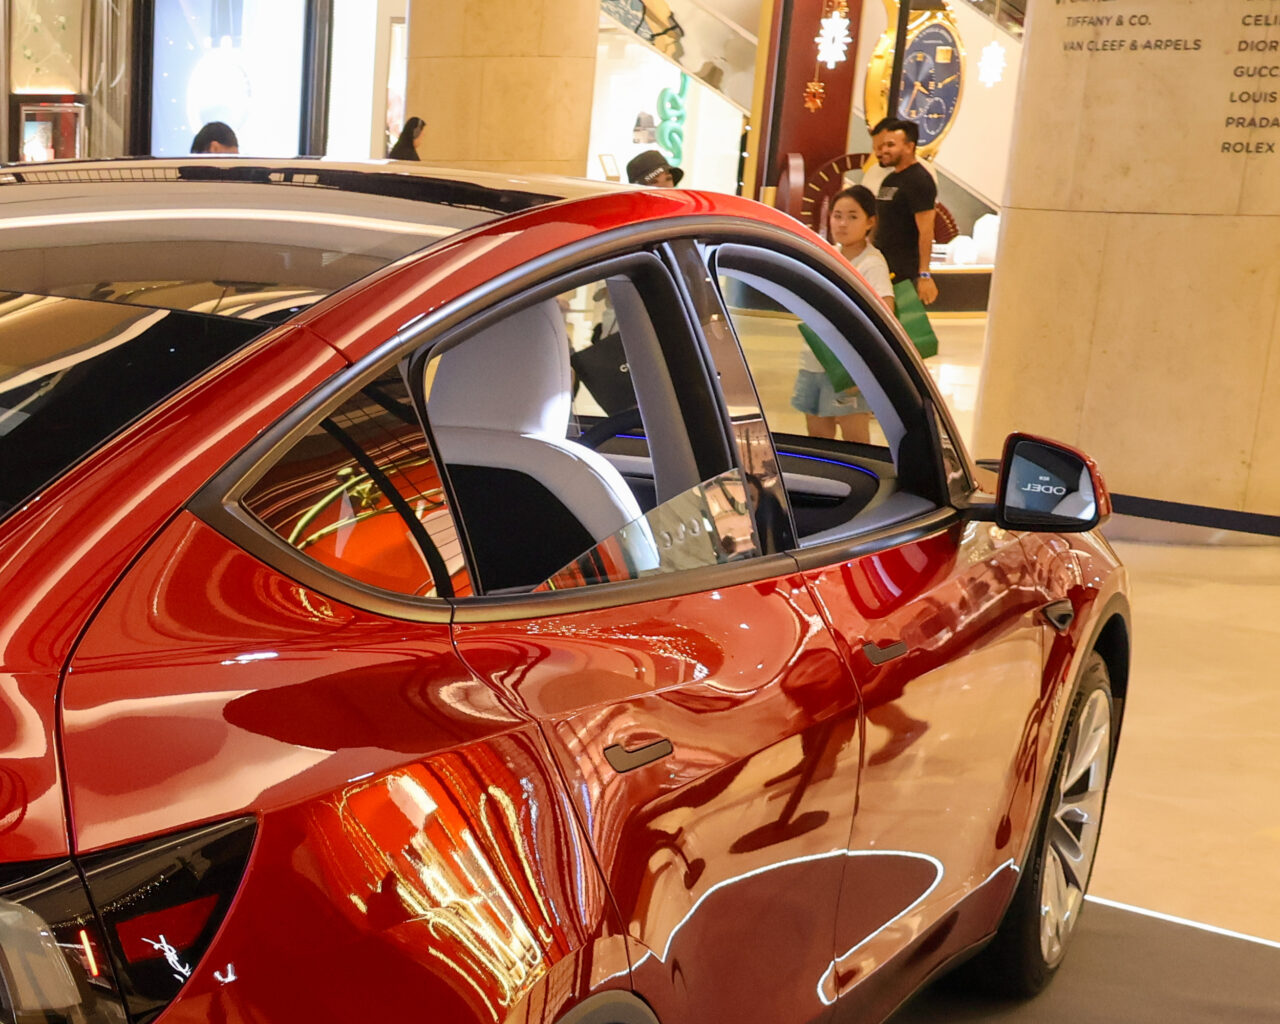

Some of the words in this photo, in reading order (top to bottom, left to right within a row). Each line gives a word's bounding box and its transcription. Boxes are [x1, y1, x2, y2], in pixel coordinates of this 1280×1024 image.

[1066, 15, 1113, 26] TIFFANY
[1115, 15, 1124, 26] &
[1128, 14, 1152, 26] CO.
[1241, 14, 1280, 26] CELI
[1063, 40, 1084, 51] VAN
[1086, 39, 1127, 51] CLEEF
[1129, 39, 1139, 51] &
[1140, 39, 1202, 51] ARPELS
[1237, 40, 1280, 52] DIOR
[1233, 65, 1280, 78] GUCC
[1229, 91, 1278, 104] LOUIS
[1225, 116, 1280, 129] PRADA
[1220, 141, 1276, 154] ROLEX
